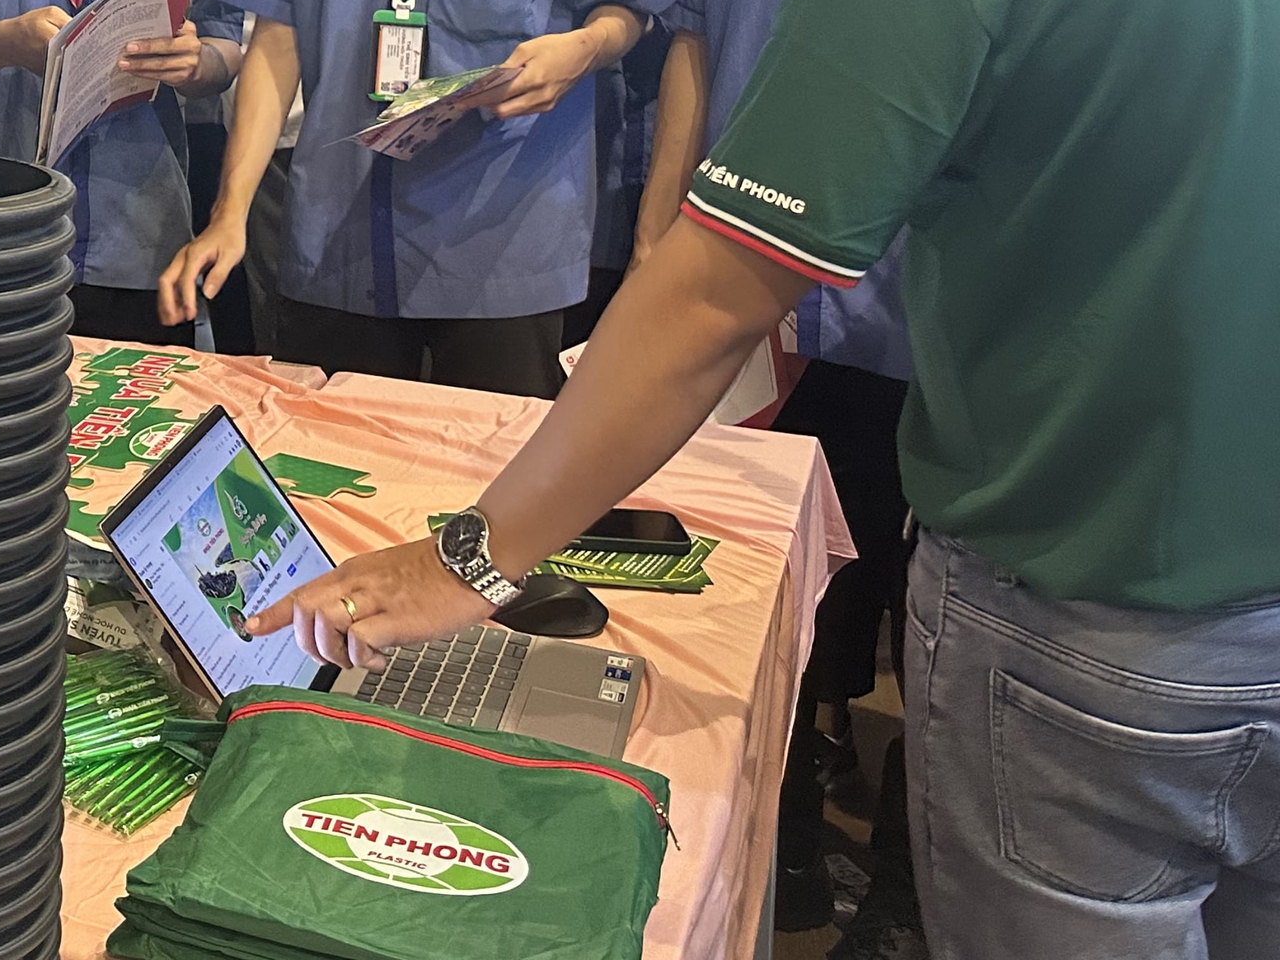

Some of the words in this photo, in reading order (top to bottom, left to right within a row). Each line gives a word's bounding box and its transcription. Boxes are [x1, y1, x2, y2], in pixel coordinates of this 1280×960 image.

[740, 178, 806, 214] PHONG
[301, 813, 380, 843] TIEN
[384, 835, 511, 874] PHONG
[367, 851, 428, 871] PLASTIC
